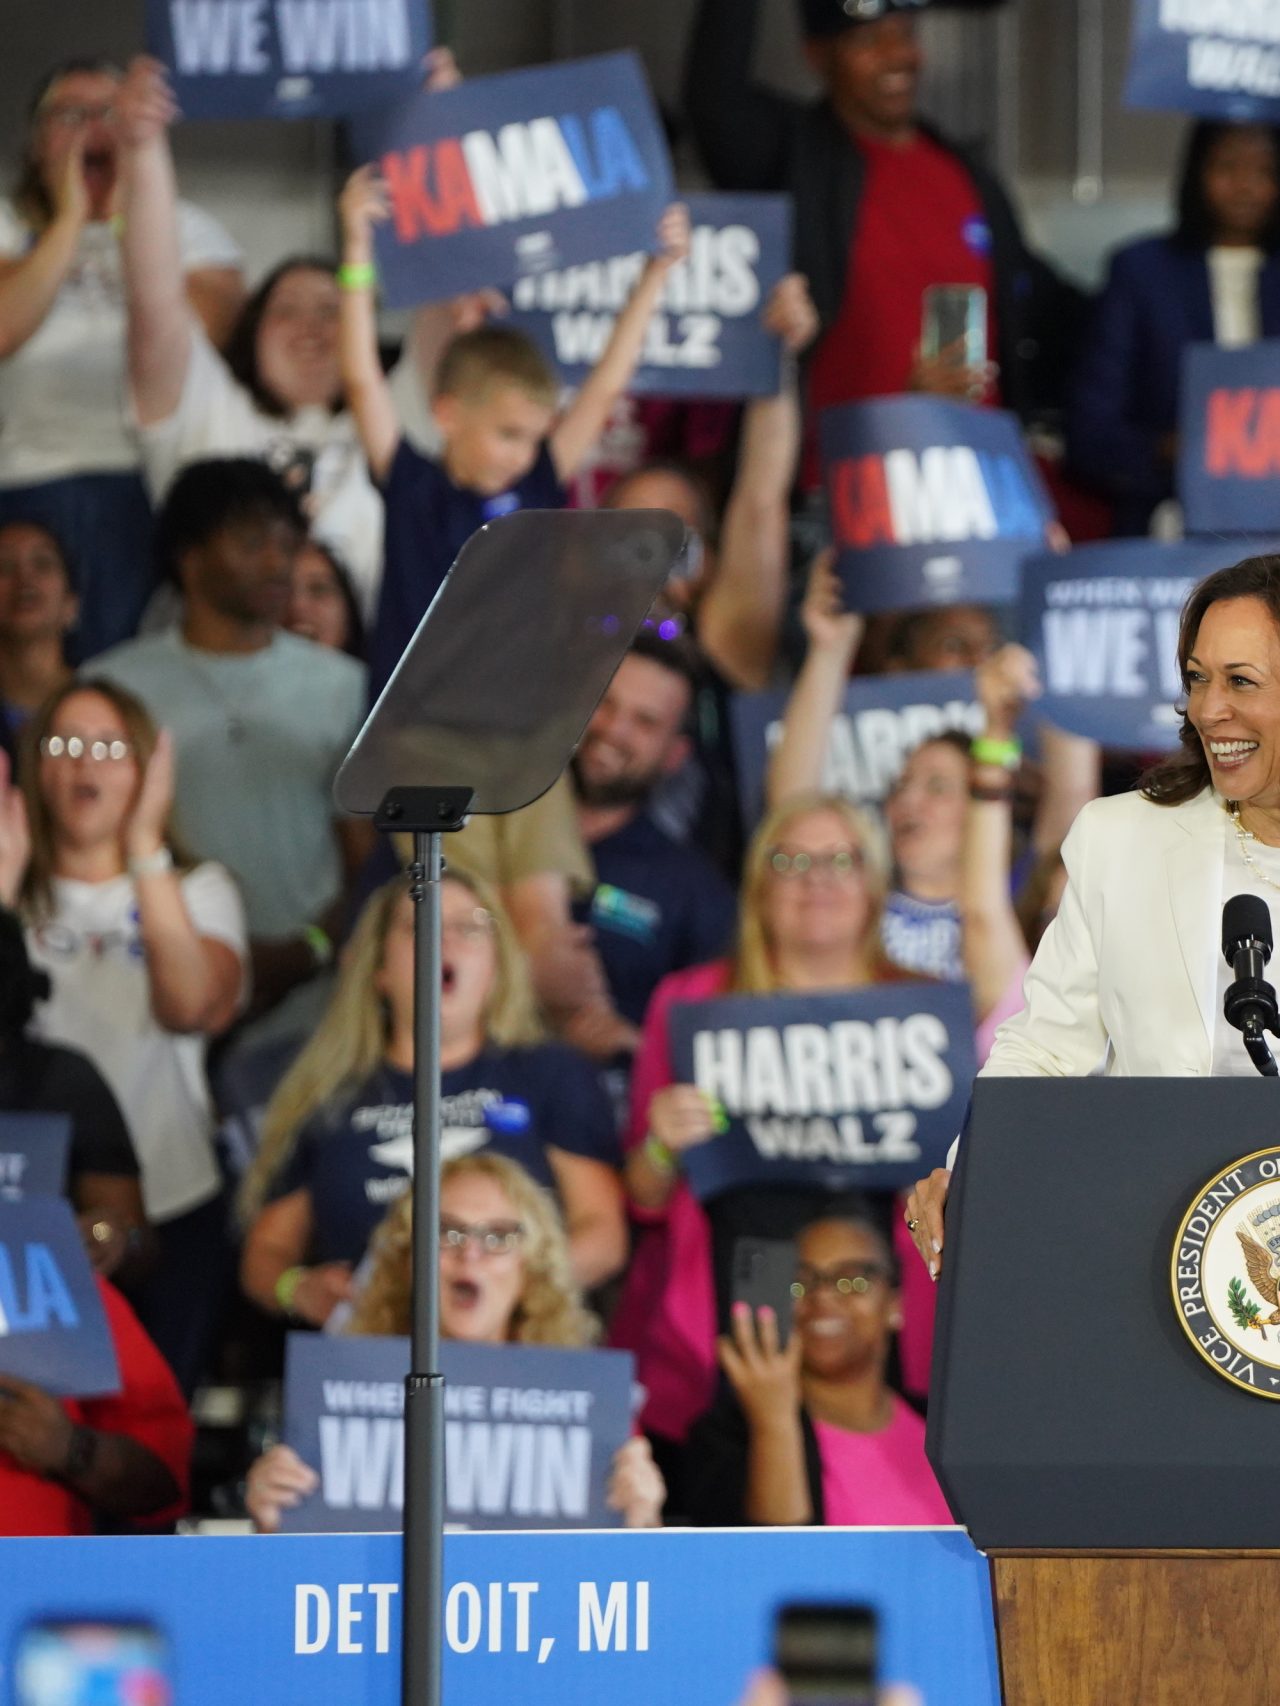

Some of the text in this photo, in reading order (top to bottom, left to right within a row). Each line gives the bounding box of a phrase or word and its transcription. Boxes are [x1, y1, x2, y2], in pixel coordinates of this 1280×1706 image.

[170, 0, 408, 75] WE WIN
[381, 106, 650, 243] KAMALA
[551, 314, 723, 368] WLZ
[1042, 607, 1150, 698] WE
[692, 1012, 953, 1118] HARRIS
[746, 1110, 922, 1164] WALZ
[1177, 1168, 1245, 1319] PRESIDENT
[1198, 1326, 1255, 1385] VICE
[322, 1379, 404, 1416] WHE
[490, 1386, 594, 1424] FIGHT
[445, 1420, 593, 1519] WIN
[295, 1581, 649, 1663] DETOIT, MI
